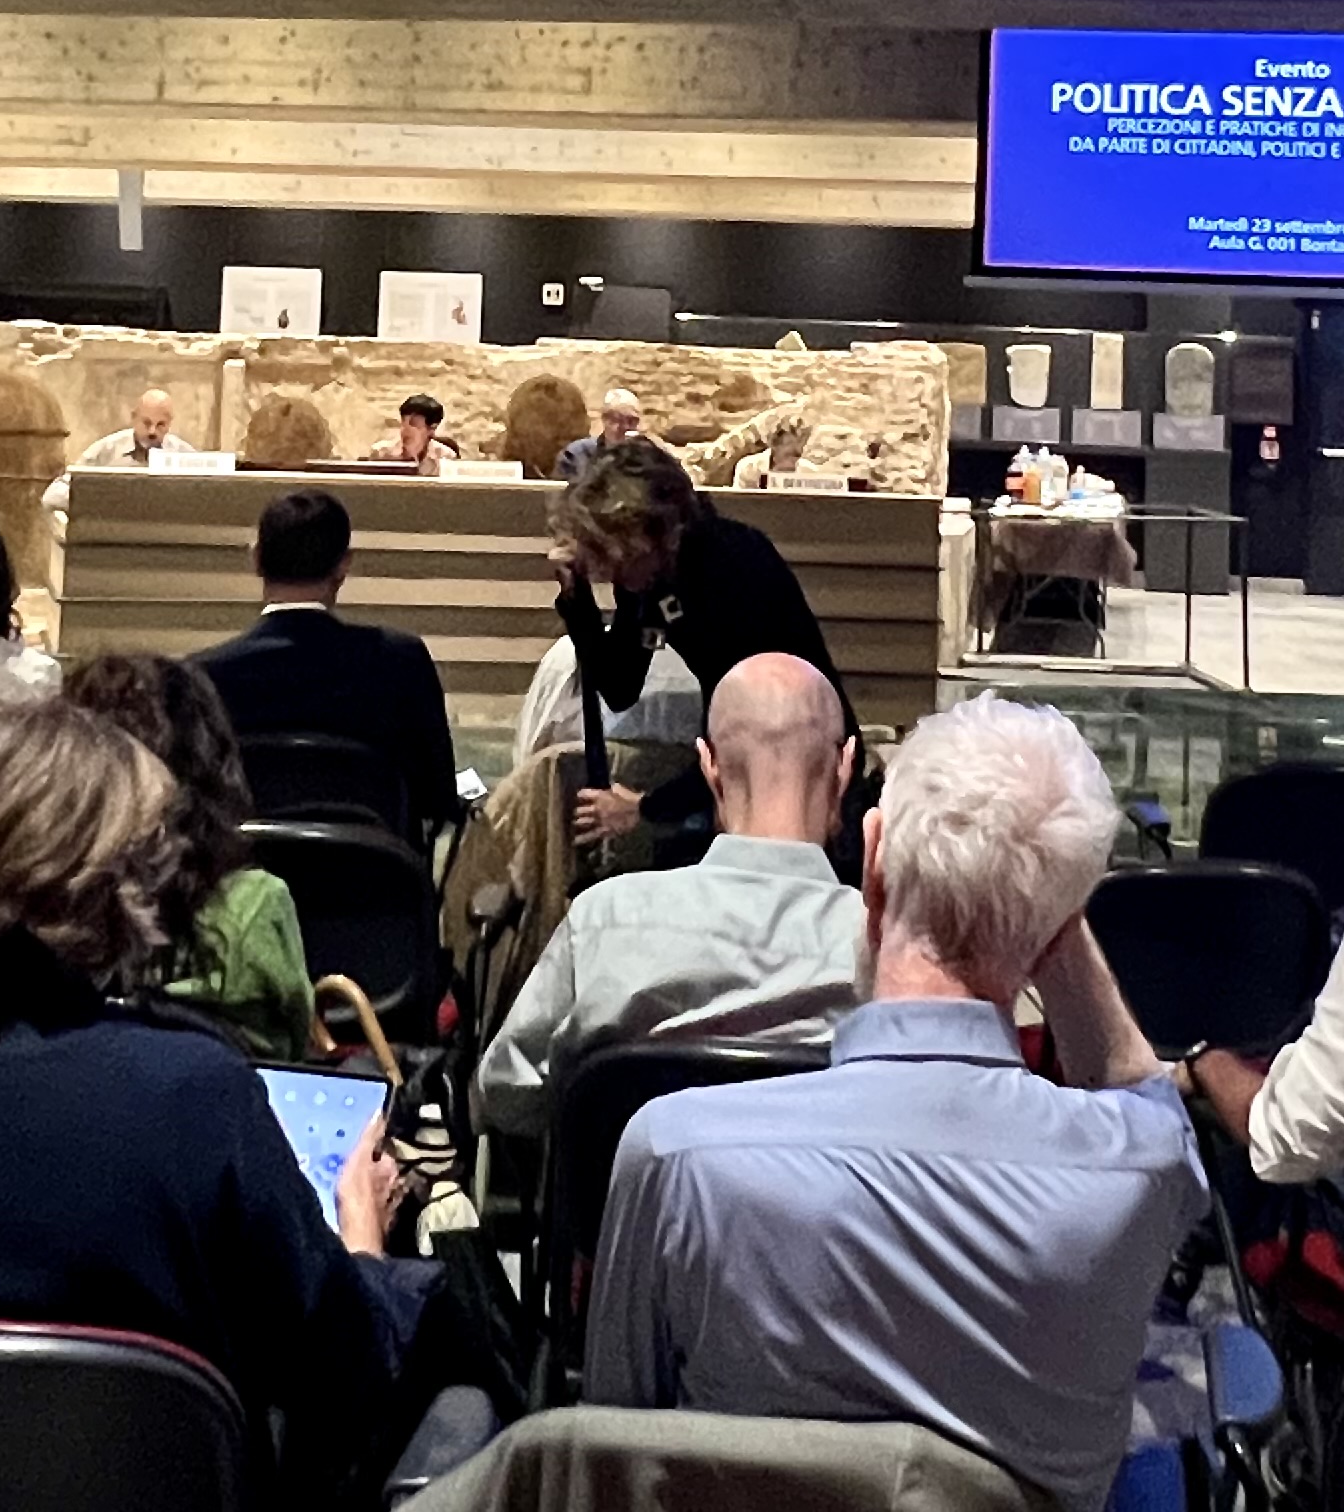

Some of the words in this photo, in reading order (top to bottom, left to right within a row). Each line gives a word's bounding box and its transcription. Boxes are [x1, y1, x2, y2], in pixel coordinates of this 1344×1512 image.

[1254, 58, 1332, 79] Evento
[1051, 82, 1214, 116] POLITICA
[1107, 117, 1202, 135] PERCEZIONI
[1204, 118, 1216, 136] E
[1219, 120, 1298, 138] PRATICHE
[1302, 121, 1320, 138] DI
[1068, 136, 1096, 152] DA
[1098, 136, 1148, 154] PARTE
[1152, 138, 1171, 154] DI
[1173, 138, 1257, 158] CITTADINI,
[1260, 140, 1326, 158] POLITICI
[1330, 142, 1341, 159] E
[1250, 218, 1272, 233] 23
[1208, 234, 1246, 250] Aula
[1266, 236, 1296, 252] 001
